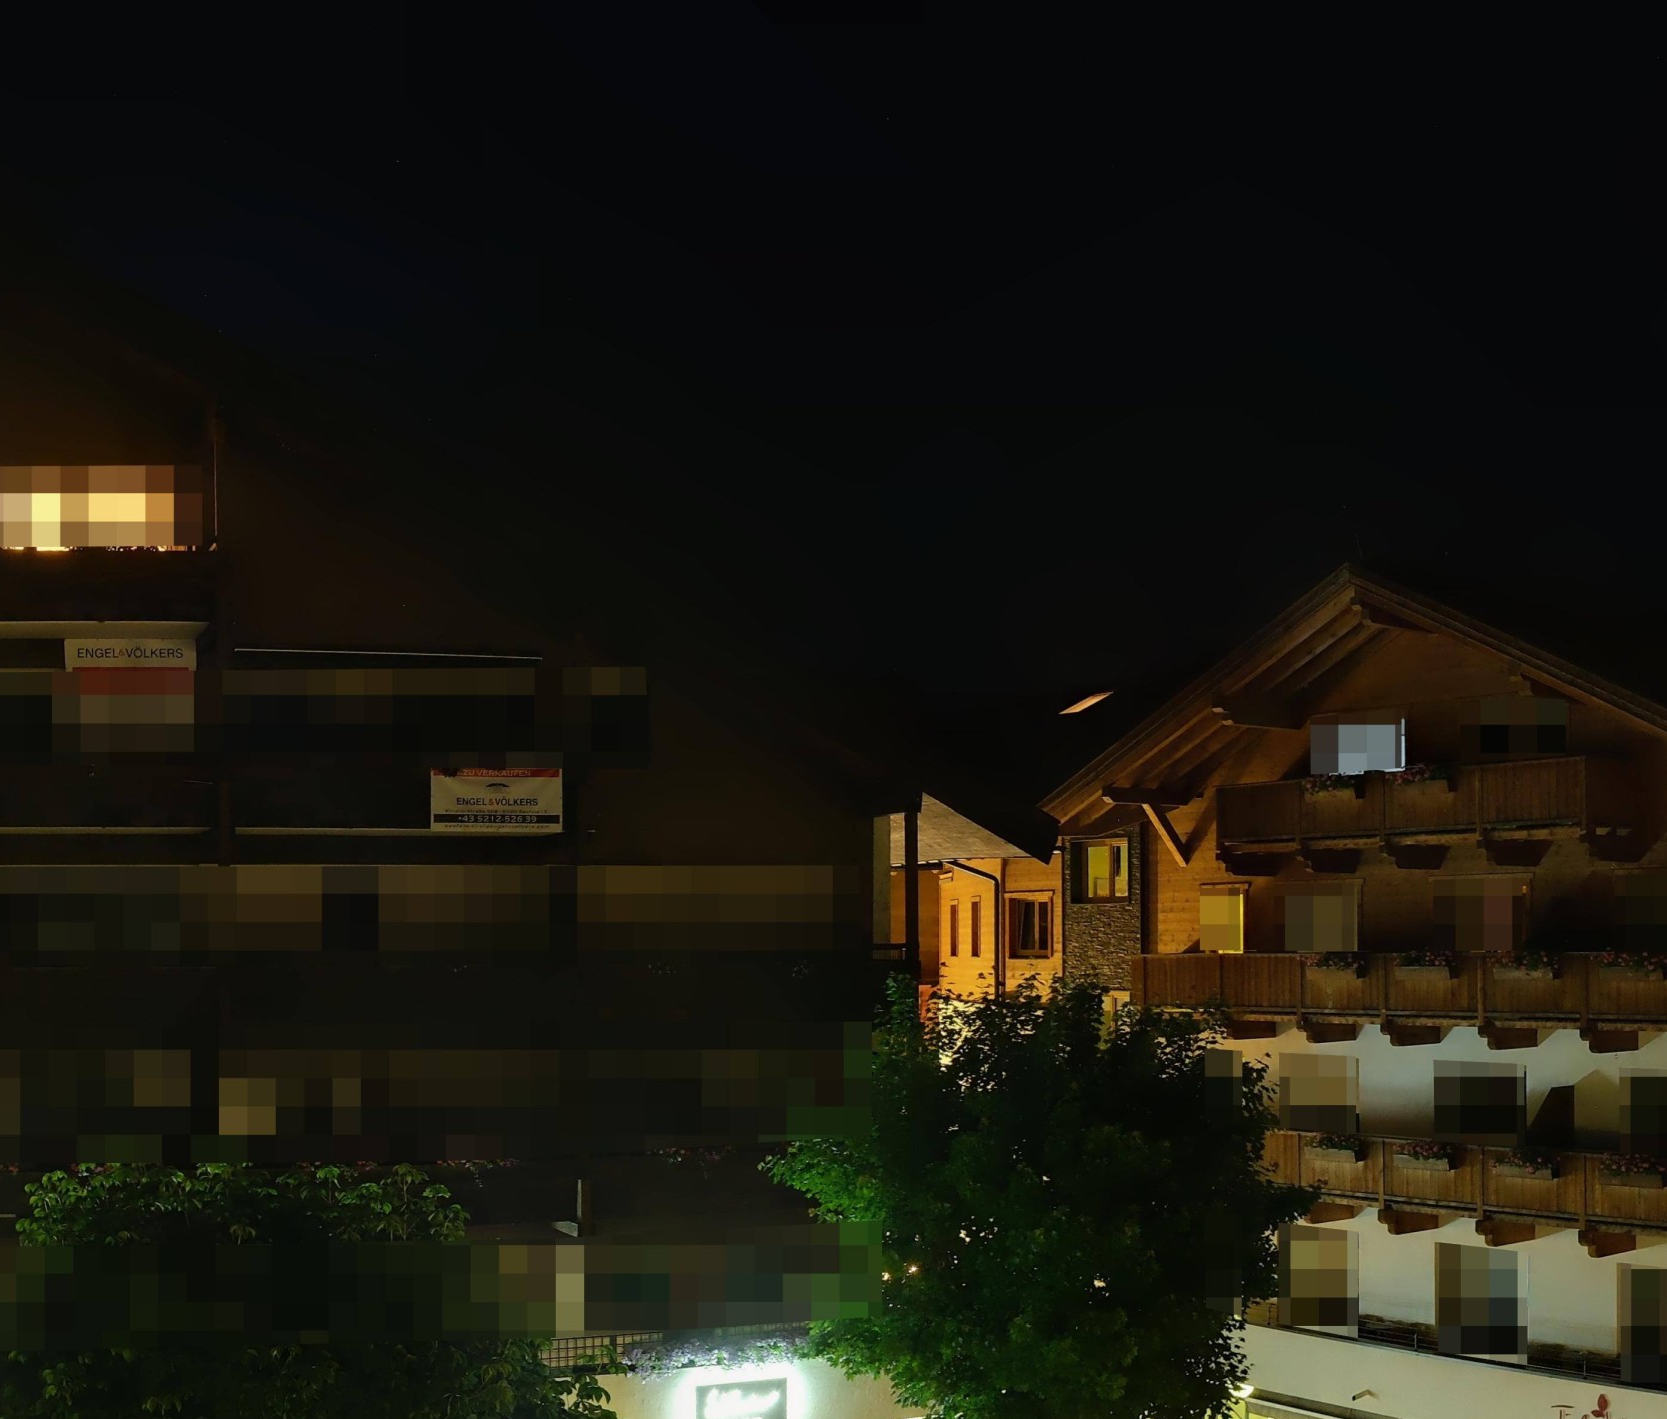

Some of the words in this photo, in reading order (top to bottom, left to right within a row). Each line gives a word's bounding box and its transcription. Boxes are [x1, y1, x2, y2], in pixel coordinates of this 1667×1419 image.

[77, 646, 184, 659] ENGEL&VÖLKERS
[477, 769, 531, 777] VERKAUFEN
[456, 796, 539, 806] ENGEL&VÖLKERS
